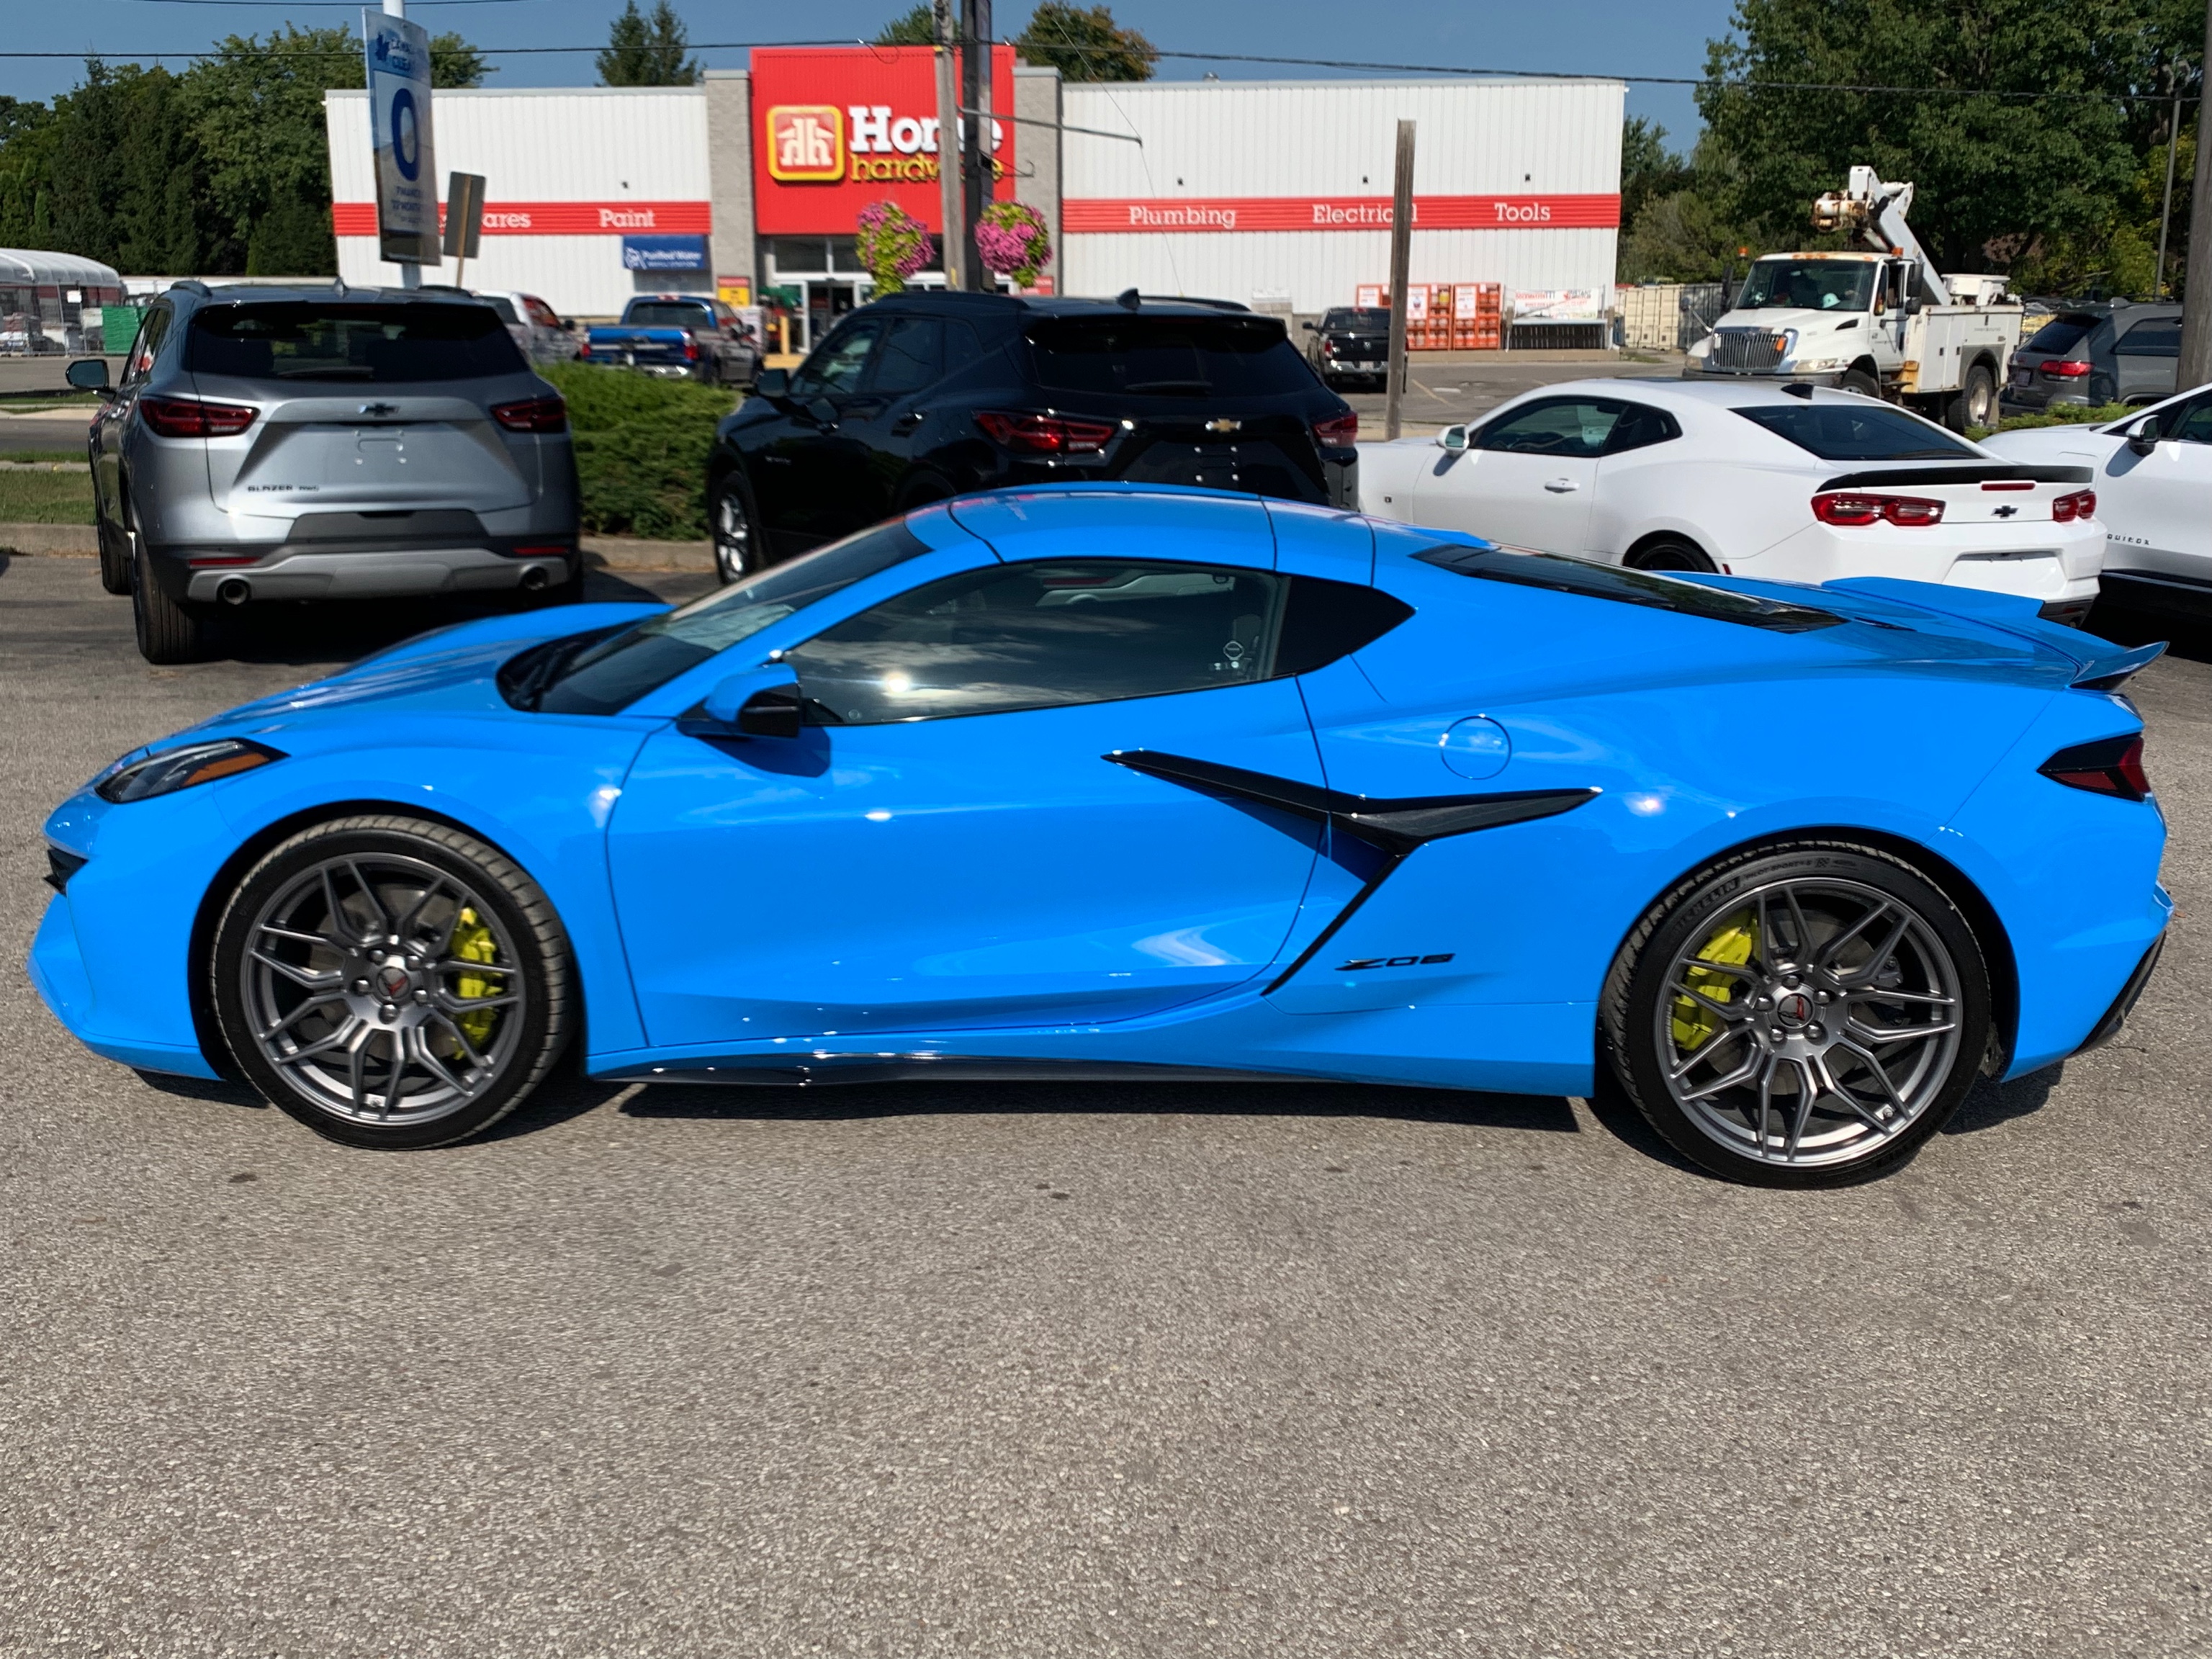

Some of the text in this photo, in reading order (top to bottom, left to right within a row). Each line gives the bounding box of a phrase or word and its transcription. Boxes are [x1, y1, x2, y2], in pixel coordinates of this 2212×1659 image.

[598, 207, 657, 228] Paint
[1129, 205, 1237, 230] Plumbing
[1313, 204, 1418, 224] Electricl
[1494, 202, 1551, 222] Tools
